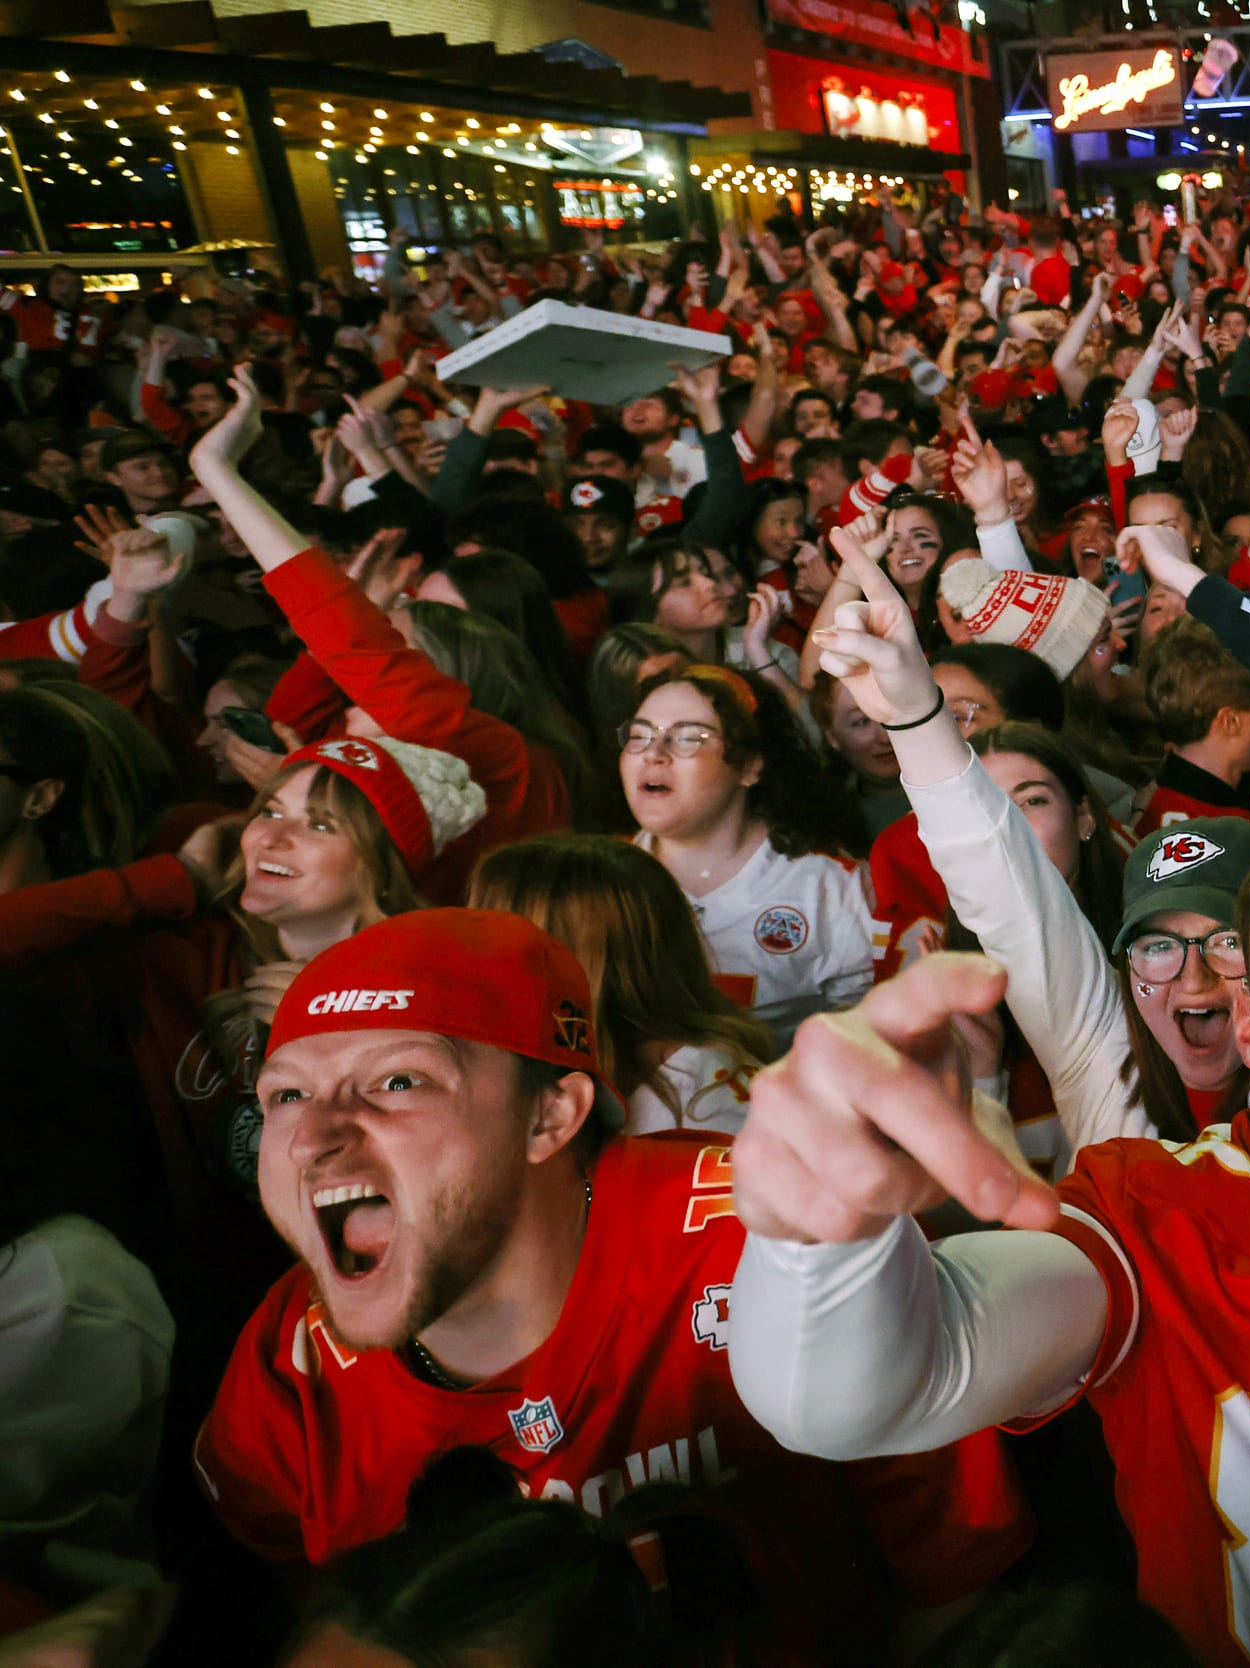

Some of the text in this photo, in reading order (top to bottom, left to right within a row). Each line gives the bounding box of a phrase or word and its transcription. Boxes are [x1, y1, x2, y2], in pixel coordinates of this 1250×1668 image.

[1162, 836, 1205, 863] KC
[307, 989, 415, 1015] CHIEFS
[520, 1420, 558, 1447] NFL
